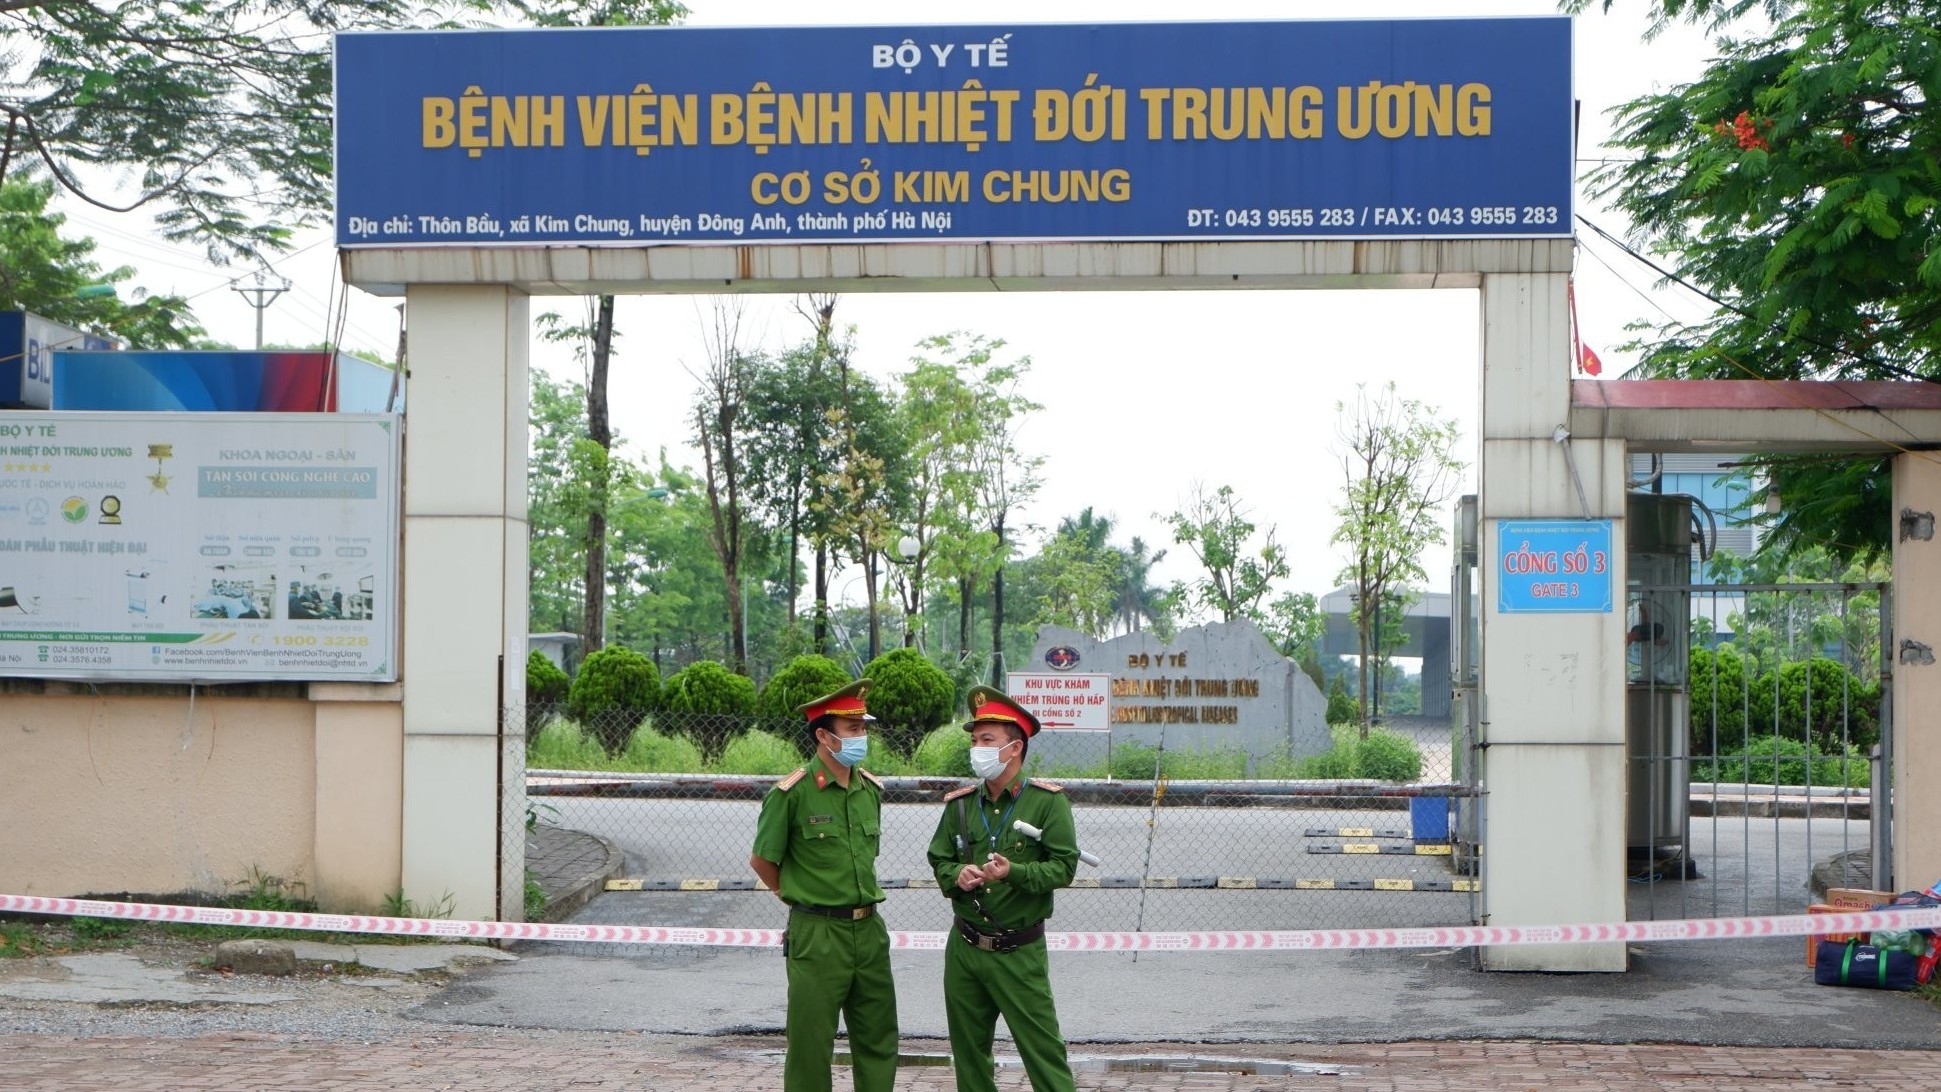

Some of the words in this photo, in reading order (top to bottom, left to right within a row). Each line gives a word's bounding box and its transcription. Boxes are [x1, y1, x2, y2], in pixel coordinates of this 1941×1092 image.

[872, 38, 922, 75] BỘ
[930, 44, 955, 67] Y
[964, 33, 1014, 67] TẾ
[422, 85, 565, 157] BỆNH
[576, 83, 698, 155] VIỆN
[710, 81, 853, 154] BỆNH
[865, 78, 1020, 152] NHIỆT
[1032, 73, 1127, 142] ĐỚI
[1140, 84, 1324, 142] TRUNG
[1337, 80, 1493, 139] ƯƠNG
[751, 169, 812, 205] CƠ
[824, 157, 882, 205] SỞ
[894, 170, 970, 203] KIM
[982, 168, 1132, 203] CHUNG
[349, 216, 378, 238] Địa
[383, 214, 414, 234] chỉ:
[418, 215, 462, 234] Thôn
[466, 212, 504, 237] Bầu,
[509, 214, 530, 233] xã
[535, 215, 569, 233] Kim
[574, 214, 634, 237] Chung,
[640, 213, 692, 235] huyện
[698, 213, 745, 236] Đông
[751, 212, 792, 233] Anh,
[797, 212, 848, 231] thành
[853, 208, 889, 233] phố
[892, 211, 916, 230] Hà
[921, 211, 952, 233] Nội
[1187, 209, 1220, 228] ĐT:
[1225, 208, 1262, 227] 043
[1267, 208, 1315, 227] 9555
[1320, 208, 1356, 226] 283
[1360, 208, 1368, 227] /
[1374, 207, 1423, 226] FAX:
[1427, 207, 1465, 225] 043
[1470, 206, 1517, 225] 9555
[1522, 206, 1559, 225] 283
[0, 424, 21, 439] BỘ
[25, 425, 35, 437] Y
[38, 423, 57, 437] TẾ
[10, 444, 39, 458] NHIỆT
[63, 446, 99, 457] TRUNG
[101, 446, 133, 457] ƯƠNG
[219, 449, 262, 461] KHOA
[1504, 540, 1558, 575] CỔNG
[1562, 541, 1589, 575] SỐ
[1593, 551, 1606, 575] 3
[1531, 582, 1568, 598] GATE
[1570, 582, 1579, 598] 3
[273, 634, 318, 646] 1900
[323, 635, 370, 646] 3228
[1128, 651, 1149, 670] BỘ
[1169, 649, 1188, 668] TẾ
[1025, 679, 1043, 689] KHU
[1045, 678, 1062, 691] VỰC
[1064, 677, 1090, 689] KHÁM
[1041, 693, 1070, 705] TRÙNG
[1087, 692, 1105, 706] HẤP
[1042, 707, 1063, 718] CỔNG
[1064, 707, 1075, 718] SỐ
[1076, 709, 1082, 718] 2
